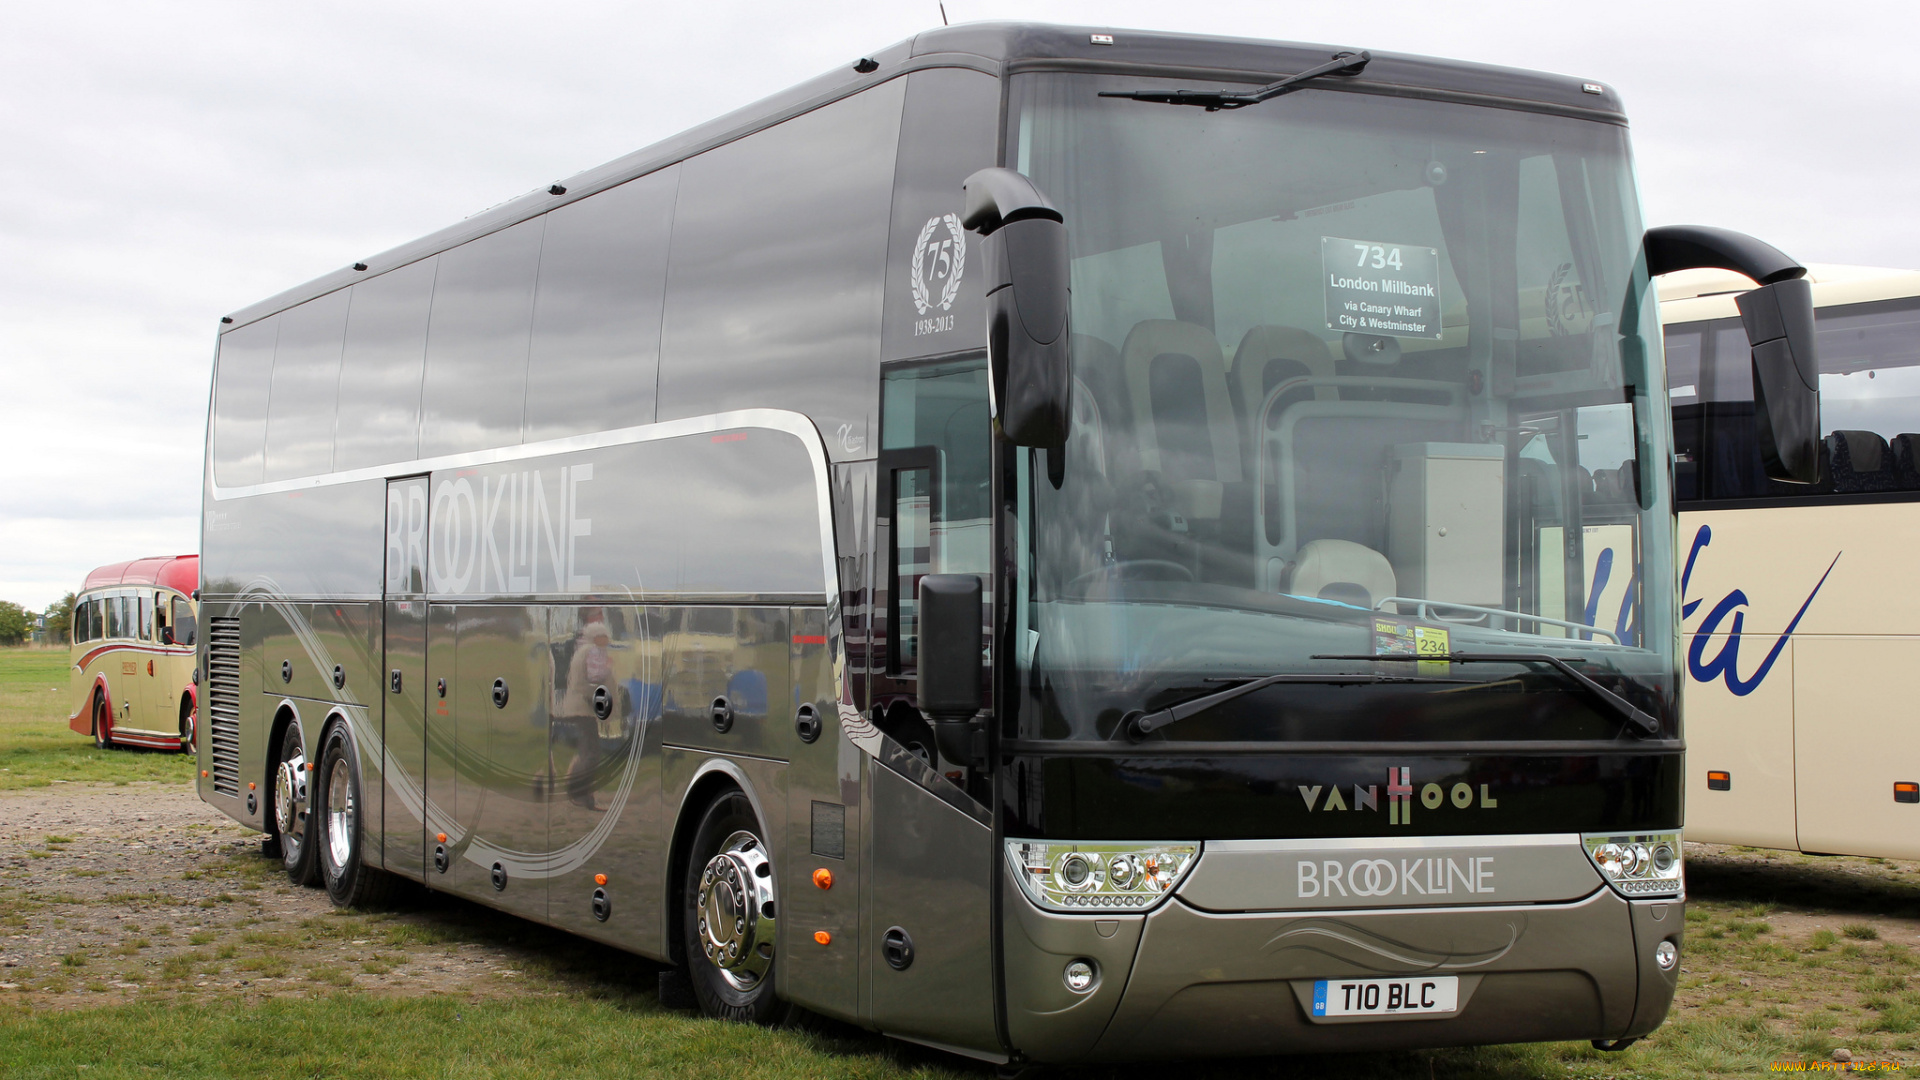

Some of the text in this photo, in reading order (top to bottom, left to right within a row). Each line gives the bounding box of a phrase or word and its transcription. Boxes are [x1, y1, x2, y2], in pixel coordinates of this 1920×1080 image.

[928, 239, 952, 281] 75
[1354, 244, 1403, 271] 734
[1331, 273, 1435, 297] London Millbank
[1344, 301, 1422, 317] via Canary Wharf
[914, 314, 954, 337] 1938-2013
[1339, 314, 1426, 333] City & Westminster
[386, 463, 593, 594] BROOKLINE
[1420, 639, 1447, 654] 234
[1298, 857, 1495, 898] BROOKLINE
[1315, 1002, 1325, 1010] GB
[1341, 982, 1436, 1010] T10 BLC
